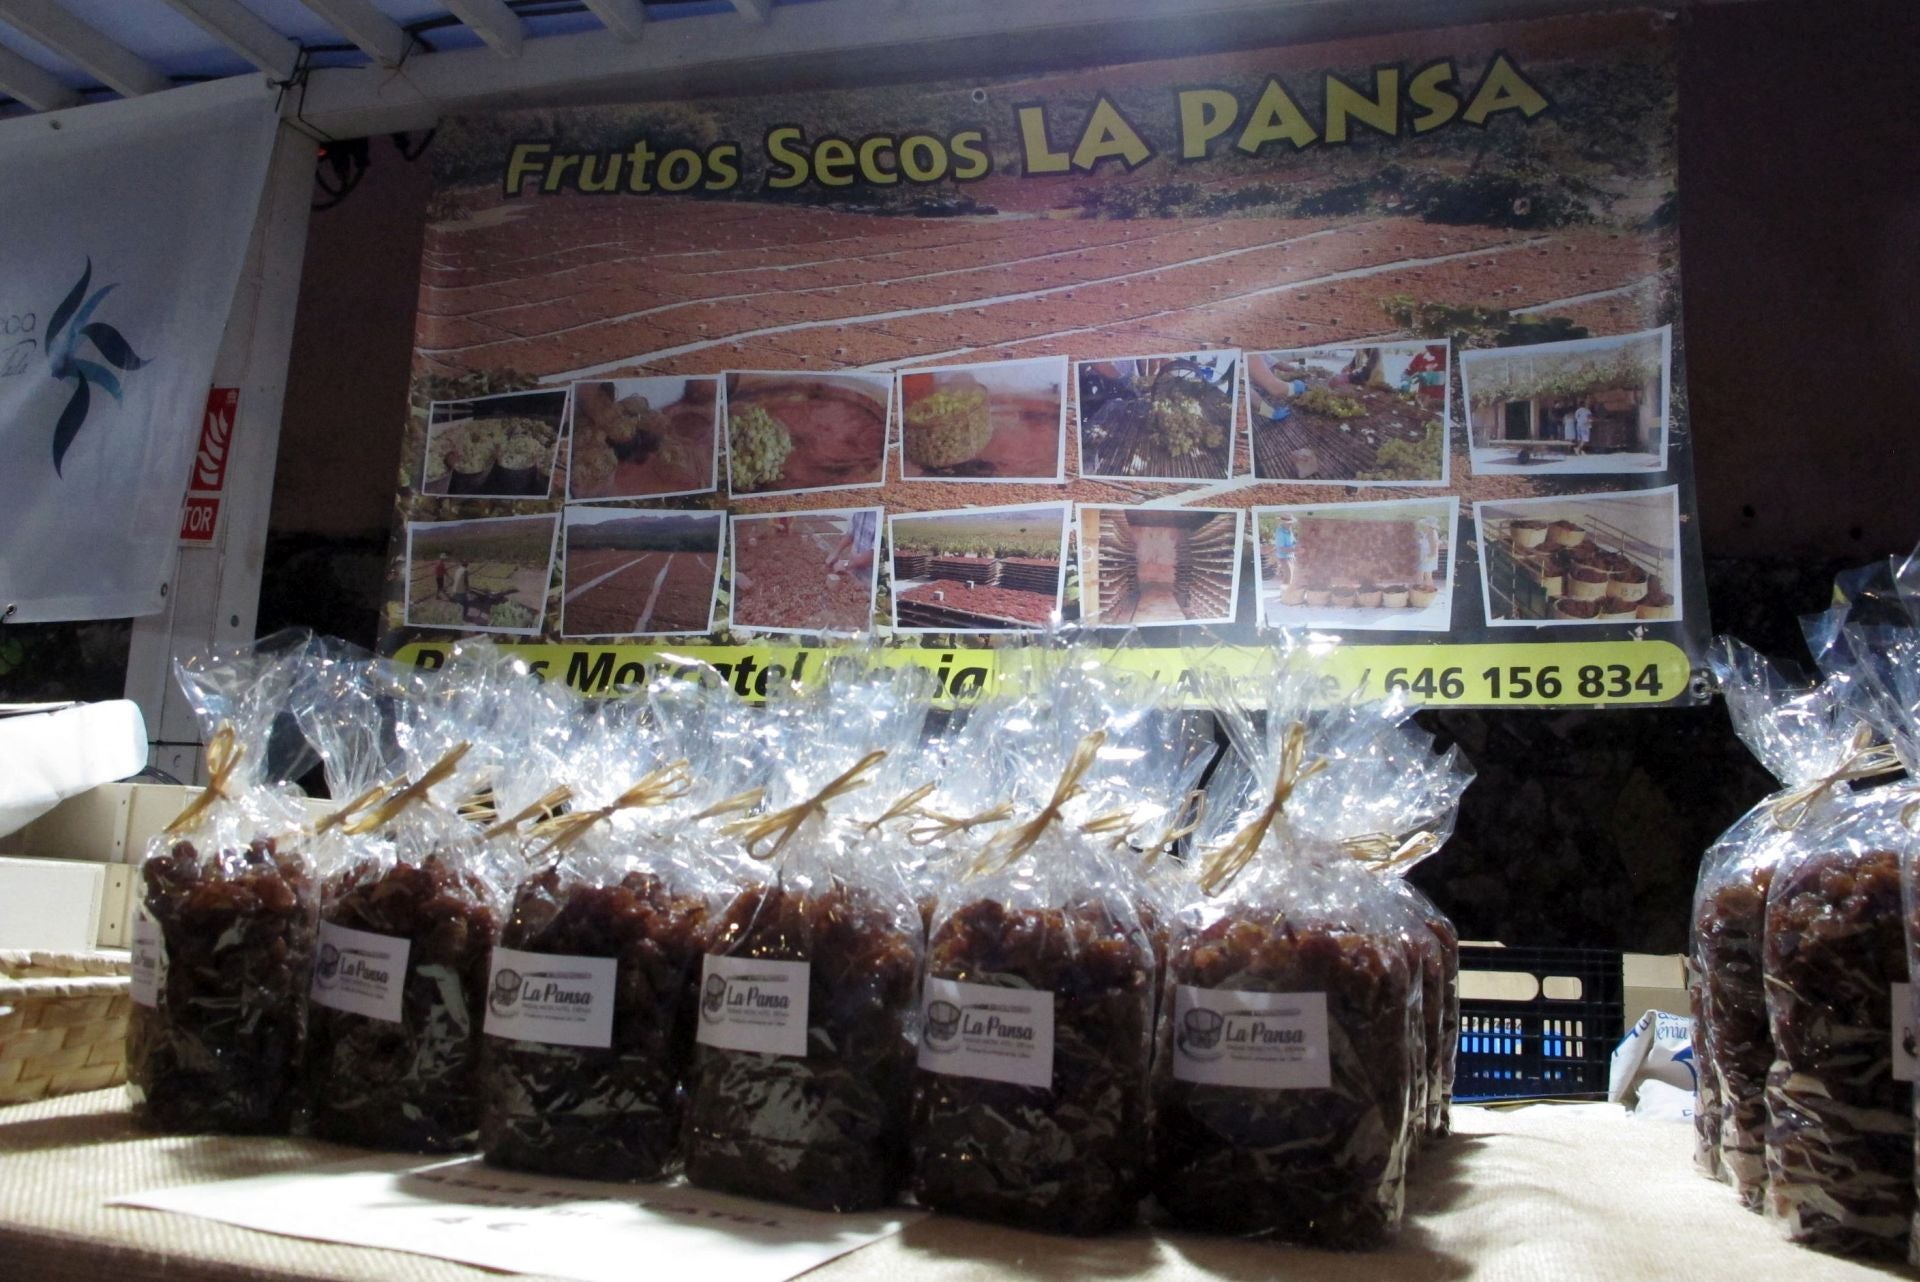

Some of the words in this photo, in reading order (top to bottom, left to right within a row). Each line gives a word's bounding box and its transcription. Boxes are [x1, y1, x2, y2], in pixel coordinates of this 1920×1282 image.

[503, 139, 742, 198] Frutos
[764, 123, 993, 190] Secos
[1016, 96, 1152, 175] LA
[1177, 54, 1551, 160] PANSA
[1384, 667, 1465, 699] 646
[1482, 665, 1562, 699] 156
[1577, 663, 1663, 698] 834
[340, 957, 355, 976] La
[522, 980, 542, 1002] La
[544, 982, 593, 1006] Pansa
[726, 985, 743, 1006] La
[746, 986, 790, 1009] Pansa
[962, 1013, 982, 1034] La
[986, 1015, 1034, 1041] Pansa
[1225, 1020, 1246, 1042] La
[1251, 1022, 1305, 1044] Pansa
